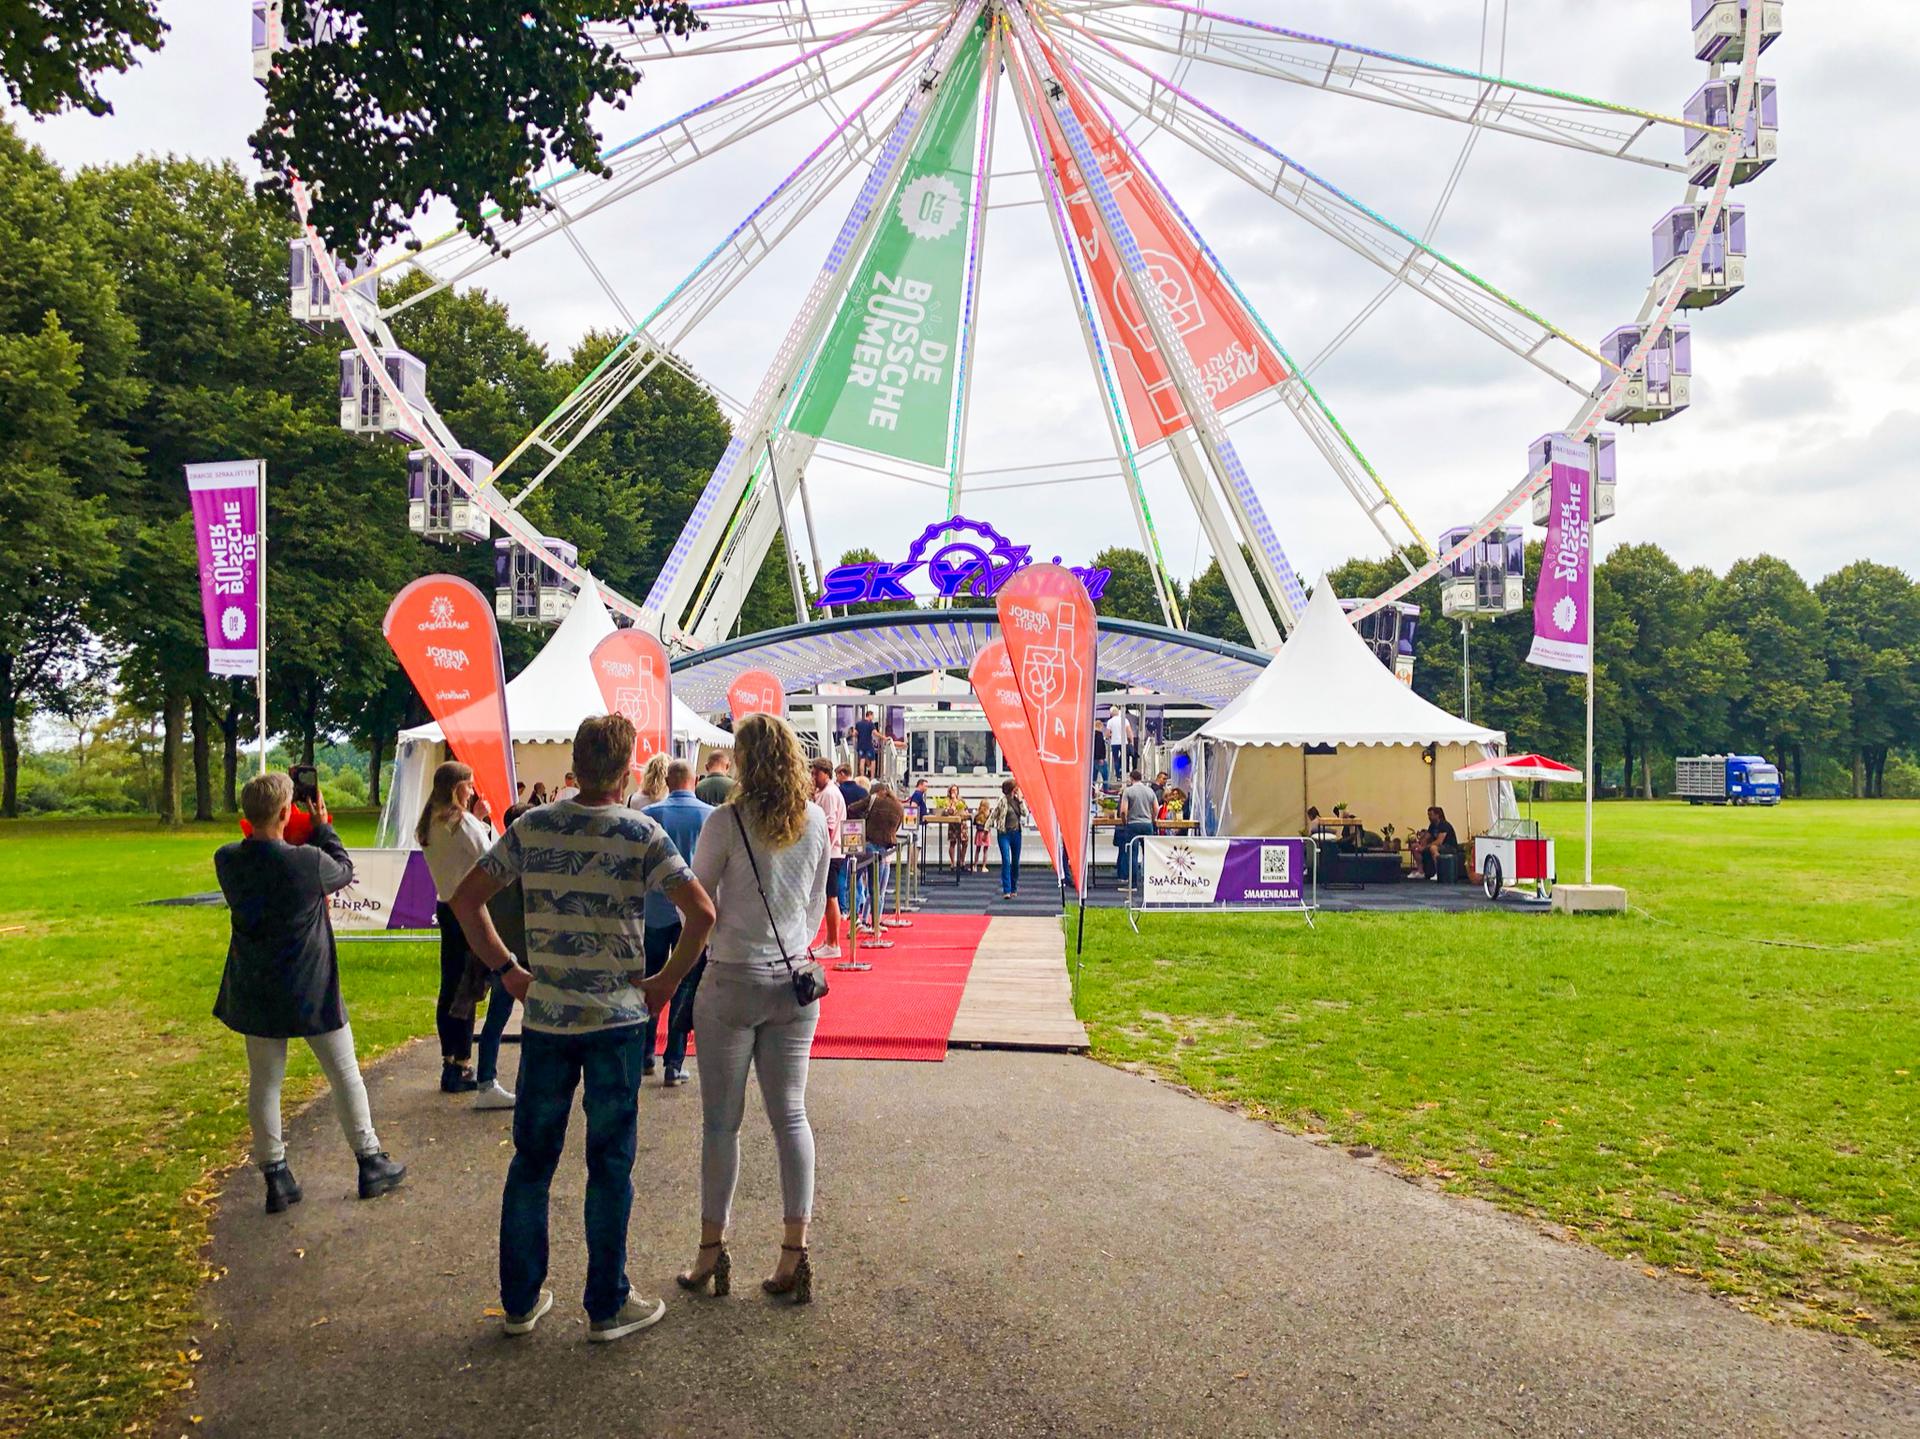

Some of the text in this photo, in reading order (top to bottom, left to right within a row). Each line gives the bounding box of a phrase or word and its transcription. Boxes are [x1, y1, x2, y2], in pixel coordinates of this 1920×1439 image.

[846, 270, 924, 388] ZOMER
[868, 278, 933, 432] BOSSCHE
[915, 341, 948, 386] DE
[1201, 344, 1260, 402] APERO
[1149, 875, 1210, 888] SMAKENRAD
[1243, 888, 1300, 899] SMAKENRAD.NL
[332, 897, 381, 912] ENRAD
